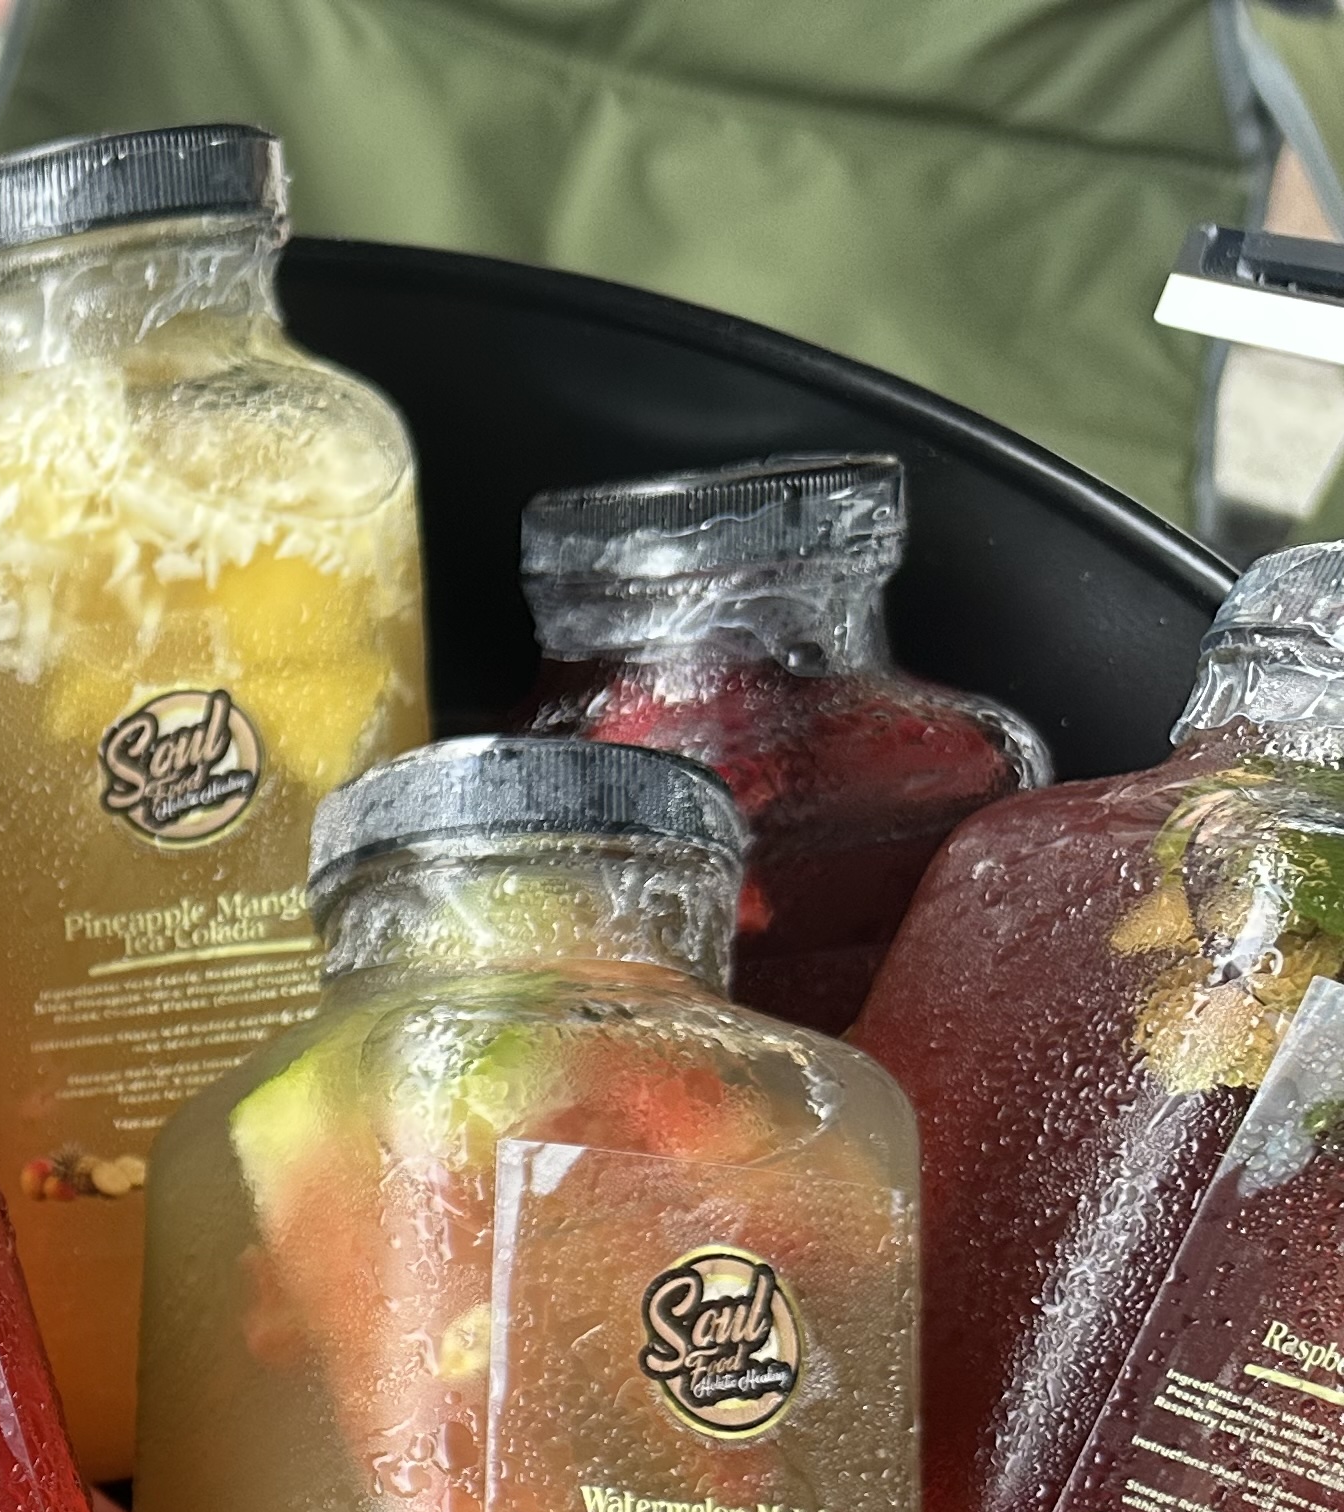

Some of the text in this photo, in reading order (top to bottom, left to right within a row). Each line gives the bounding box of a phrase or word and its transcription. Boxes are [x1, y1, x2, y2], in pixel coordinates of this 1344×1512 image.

[105, 697, 227, 810] Soul
[66, 898, 208, 941] Pineapple
[121, 912, 266, 956] Tea Colada
[644, 1273, 769, 1373] Soul
[684, 1344, 743, 1391] Food
